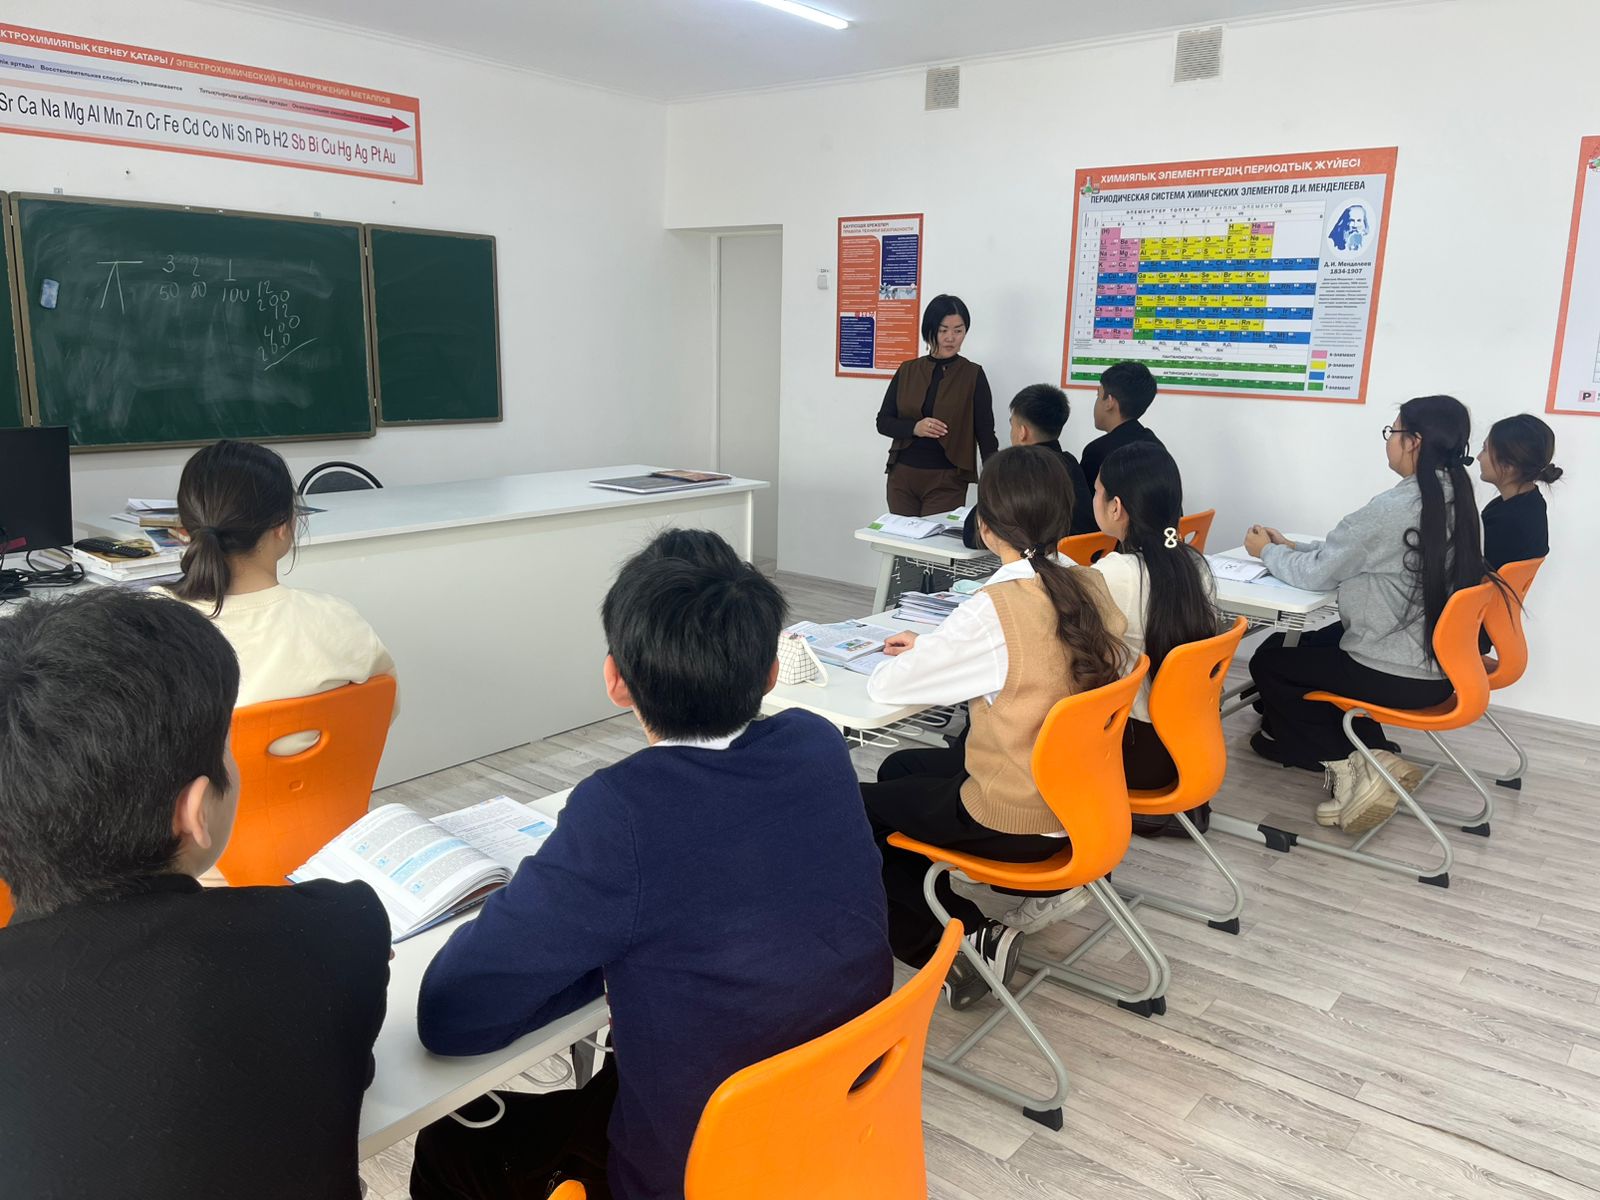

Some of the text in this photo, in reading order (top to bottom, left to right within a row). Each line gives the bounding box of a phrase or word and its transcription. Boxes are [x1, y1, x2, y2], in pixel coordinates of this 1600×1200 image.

[91, 45, 128, 57] КЕРНЕУ
[130, 51, 168, 65] ҚАТАРЫ
[175, 58, 277, 83] ЭЛЕКТРОХИМИЧЕСКИЙ
[277, 76, 294, 87] РЯД
[295, 81, 350, 97] НАПРЯЖЕНИЙ
[351, 90, 391, 105] МЕТАЛЛОВ
[0, 92, 396, 164] Sr Ca Na Mg Al Mn Zn Cr Fe Cd Co Ni Sn Pb H2 Sb Bi Cu Hg Ag Pt Au
[1100, 157, 1361, 184] ХИМИЯЛЫҚ ЭЛЕМЕНТТЕРДІҢ ПЕРИОДТЫҚ ЖҮЙЕСІ
[1091, 193, 1149, 204] ПЕРИОДИЧЕСКАЯ
[1151, 190, 1185, 201] СИСТЕМА
[1187, 187, 1238, 199] ХИМИЧЕСКИХ
[1241, 184, 1289, 197] ЭЛЕМЕНТОВ
[1309, 180, 1365, 193] МЕНДЕЛЕЕВА
[162, 254, 176, 273] 3
[191, 256, 200, 277] 2
[159, 281, 180, 301] 50
[190, 281, 207, 299] 80
[258, 279, 273, 297] 12
